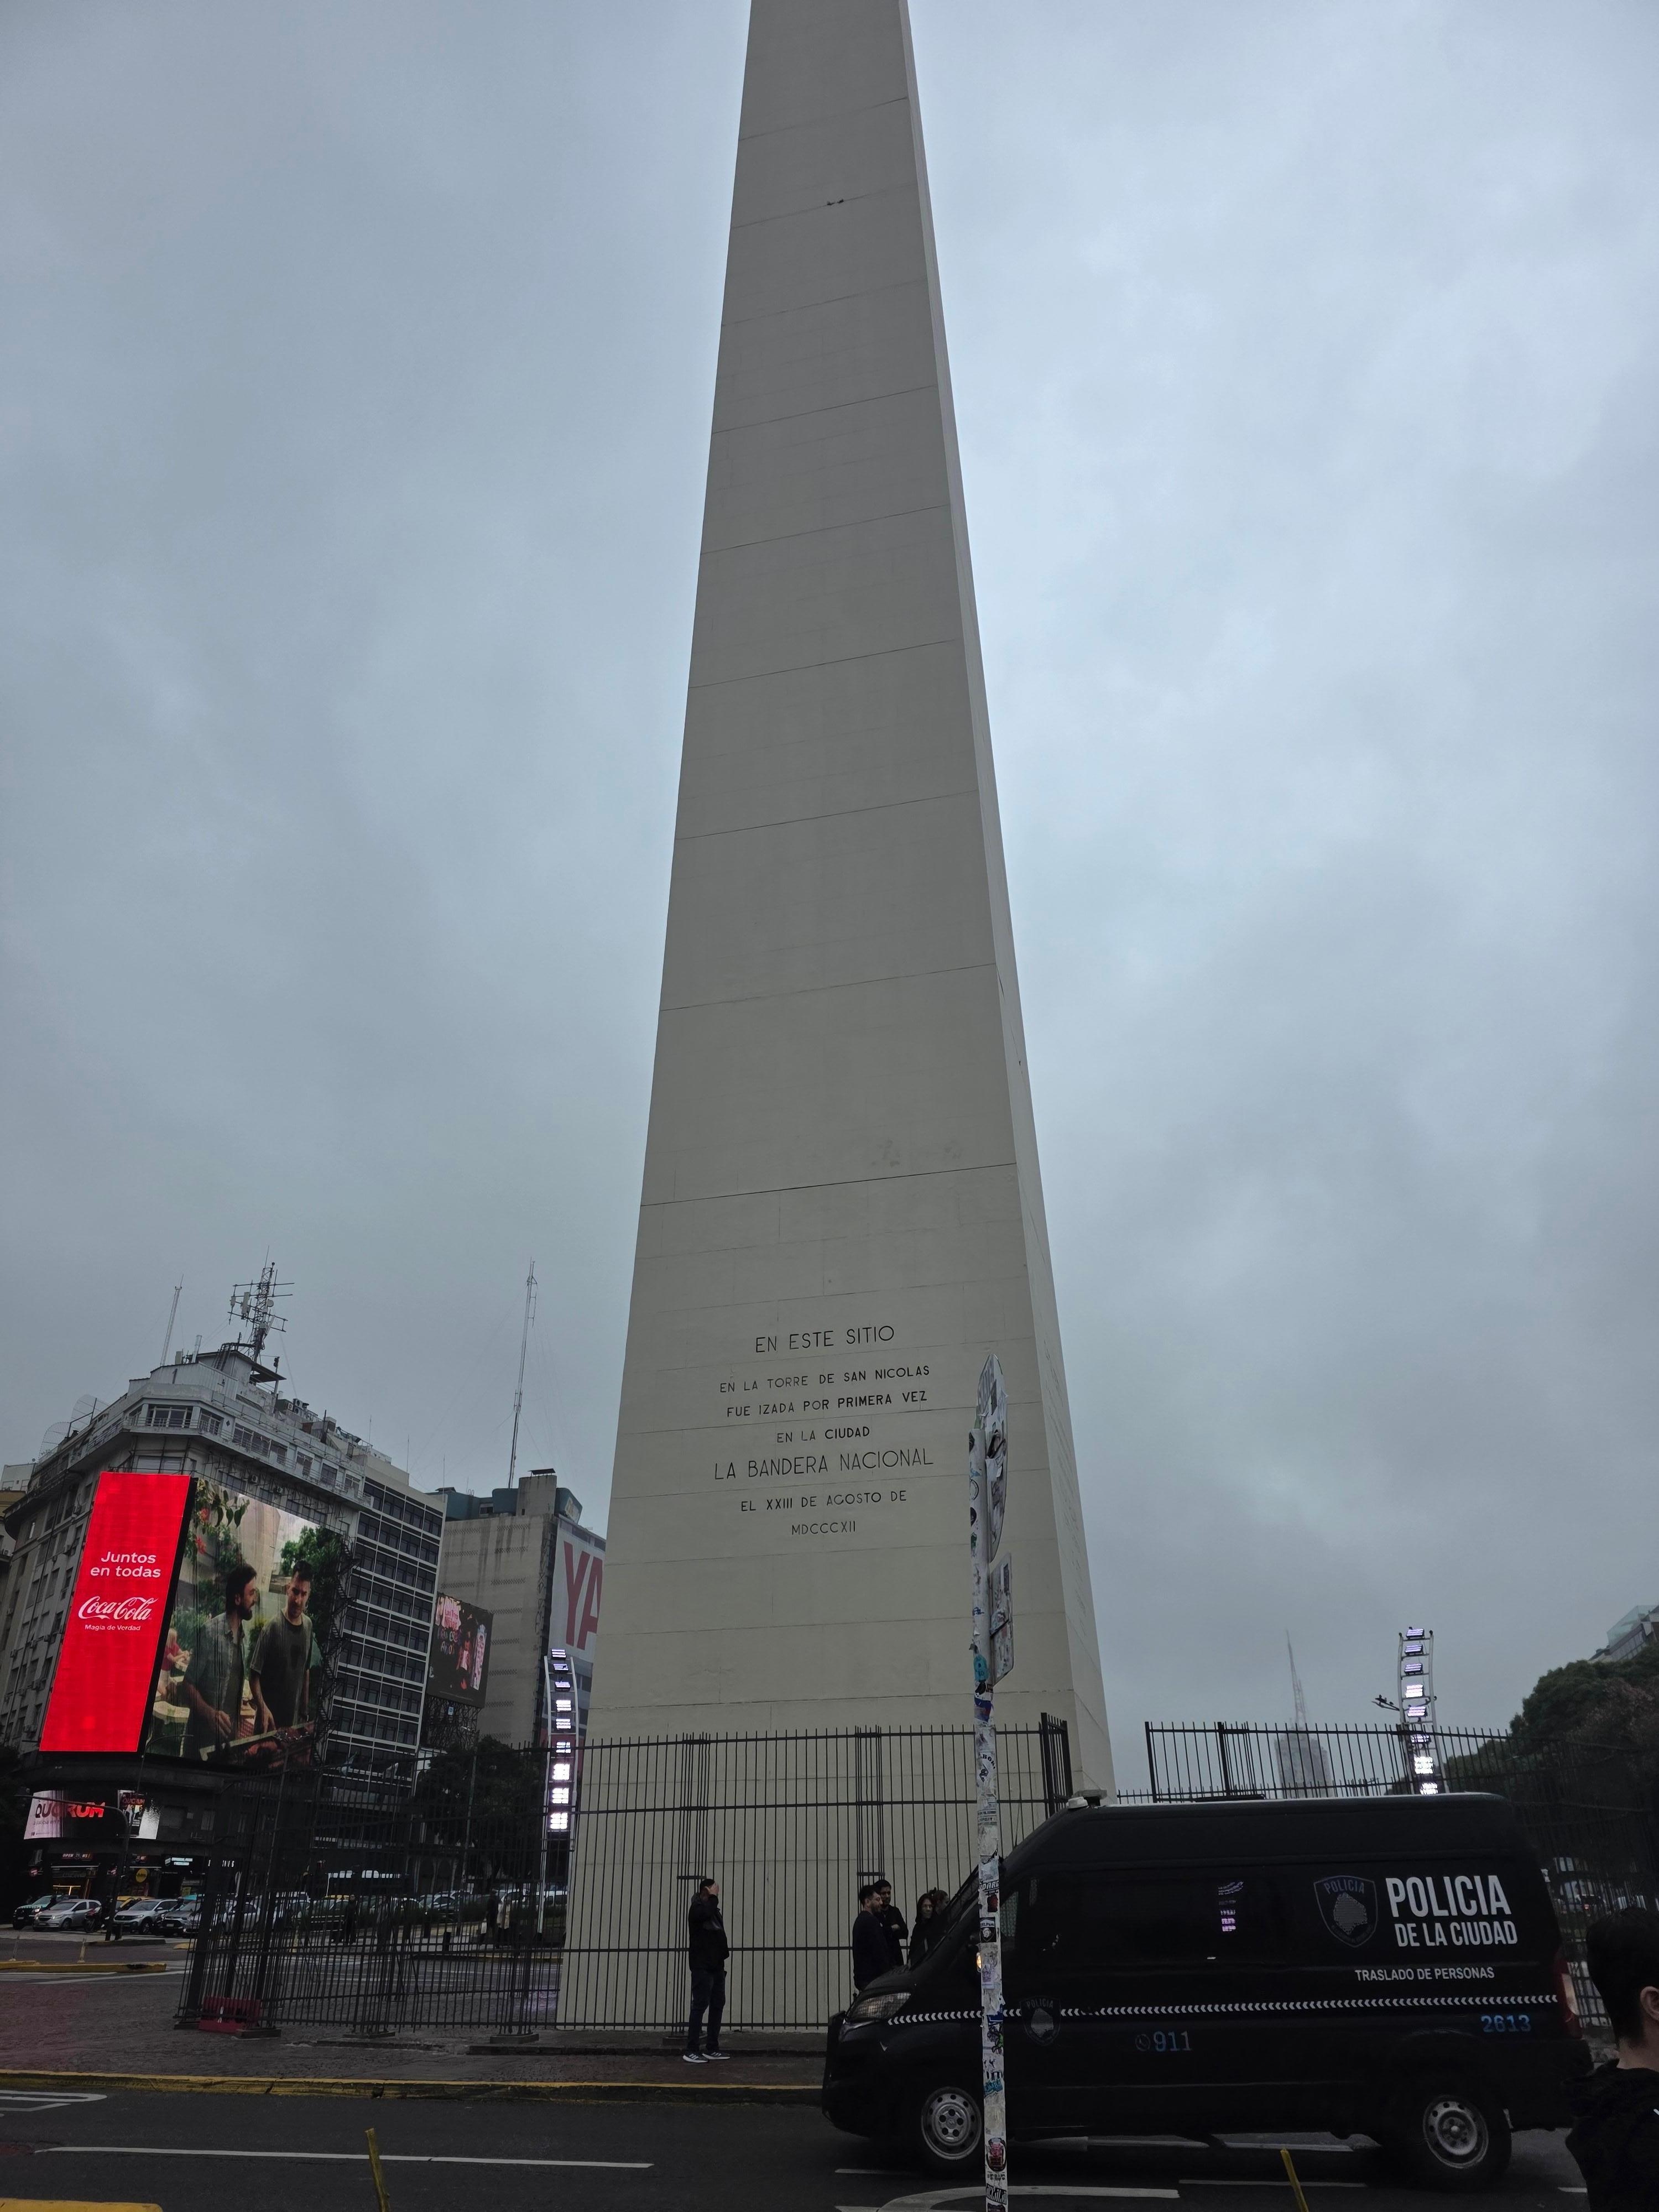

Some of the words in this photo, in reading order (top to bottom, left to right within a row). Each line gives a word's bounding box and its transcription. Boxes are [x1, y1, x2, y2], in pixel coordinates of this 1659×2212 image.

[756, 1337, 777, 1353] EN
[790, 1331, 834, 1349] ESTE
[846, 1326, 894, 1344] SITIO
[720, 1383, 735, 1392] EN
[744, 1380, 758, 1391] LA
[768, 1376, 808, 1389] TORRE
[820, 1374, 834, 1384] DE
[844, 1371, 866, 1382] SAN
[875, 1365, 930, 1379] NICOLAS
[727, 1406, 750, 1417] FUE
[759, 1402, 794, 1415] IZADA
[804, 1399, 829, 1411] POR
[838, 1394, 891, 1408] PRIMERA
[902, 1391, 927, 1403] VEZ
[777, 1432, 792, 1443] EN
[801, 1430, 816, 1441] LA
[825, 1426, 870, 1439] CIUDAD
[715, 1462, 735, 1480] LA
[748, 1455, 828, 1478] BANDERA
[840, 1448, 933, 1472] NACIONAL
[741, 1501, 756, 1511] EL
[766, 1498, 792, 1510] XXIII
[801, 1496, 817, 1508] DE
[827, 1492, 881, 1506] AGOSTO
[890, 1490, 906, 1502] DE
[792, 1521, 855, 1536] MDCCCXII
[101, 1551, 156, 1564] Juntos
[91, 1567, 110, 1576] en
[116, 1566, 161, 1578] todas
[78, 1596, 159, 1620] Coca-Cola
[1324, 1879, 1364, 1894] POLICIA
[1386, 1875, 1512, 1917] POLICIA
[1395, 1923, 1420, 1947] DE
[1423, 1923, 1448, 1946] LA
[1450, 1921, 1518, 1945] CIUDAD
[1355, 1969, 1414, 1981] TRASLADO
[1417, 1968, 1432, 1980] DE
[1434, 1966, 1495, 1979] PERSONAS
[1026, 1999, 1053, 2009] POLICIA
[1480, 2015, 1531, 2033] 2613
[1153, 2031, 1193, 2052] 911
